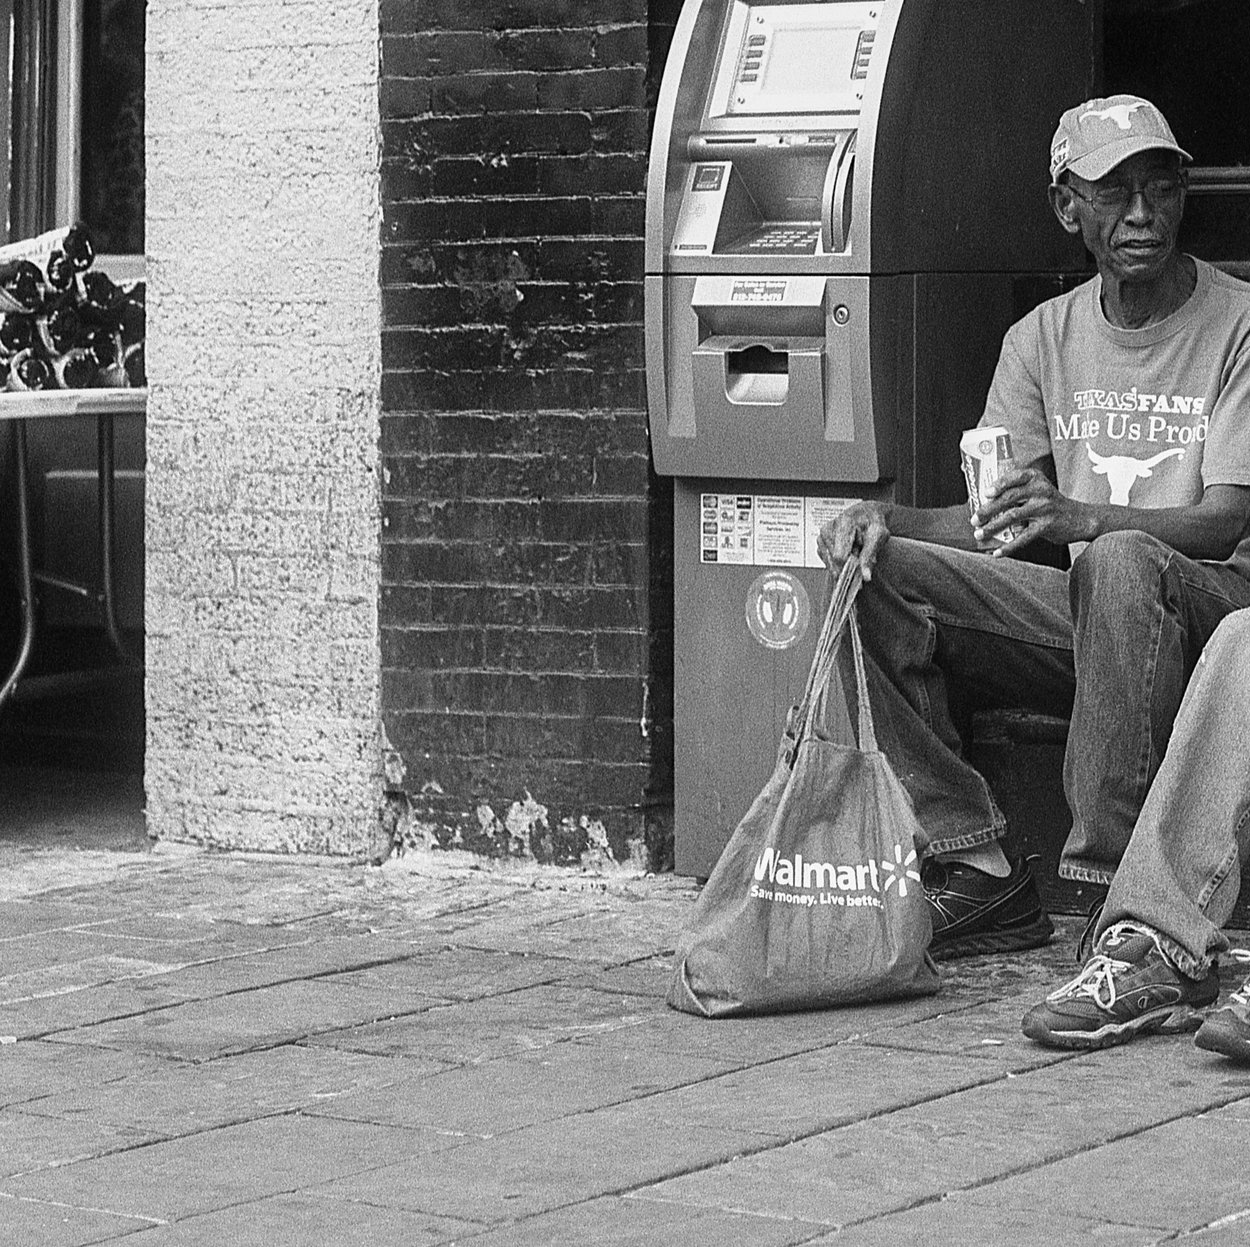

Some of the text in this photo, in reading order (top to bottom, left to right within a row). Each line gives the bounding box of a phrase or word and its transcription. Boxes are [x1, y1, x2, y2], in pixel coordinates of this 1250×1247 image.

[1137, 394, 1206, 415] FANS
[1054, 412, 1100, 441] Mae
[1106, 412, 1142, 442] Us
[754, 847, 881, 893] Walmart
[774, 892, 818, 908] money.
[819, 892, 845, 906] Live
